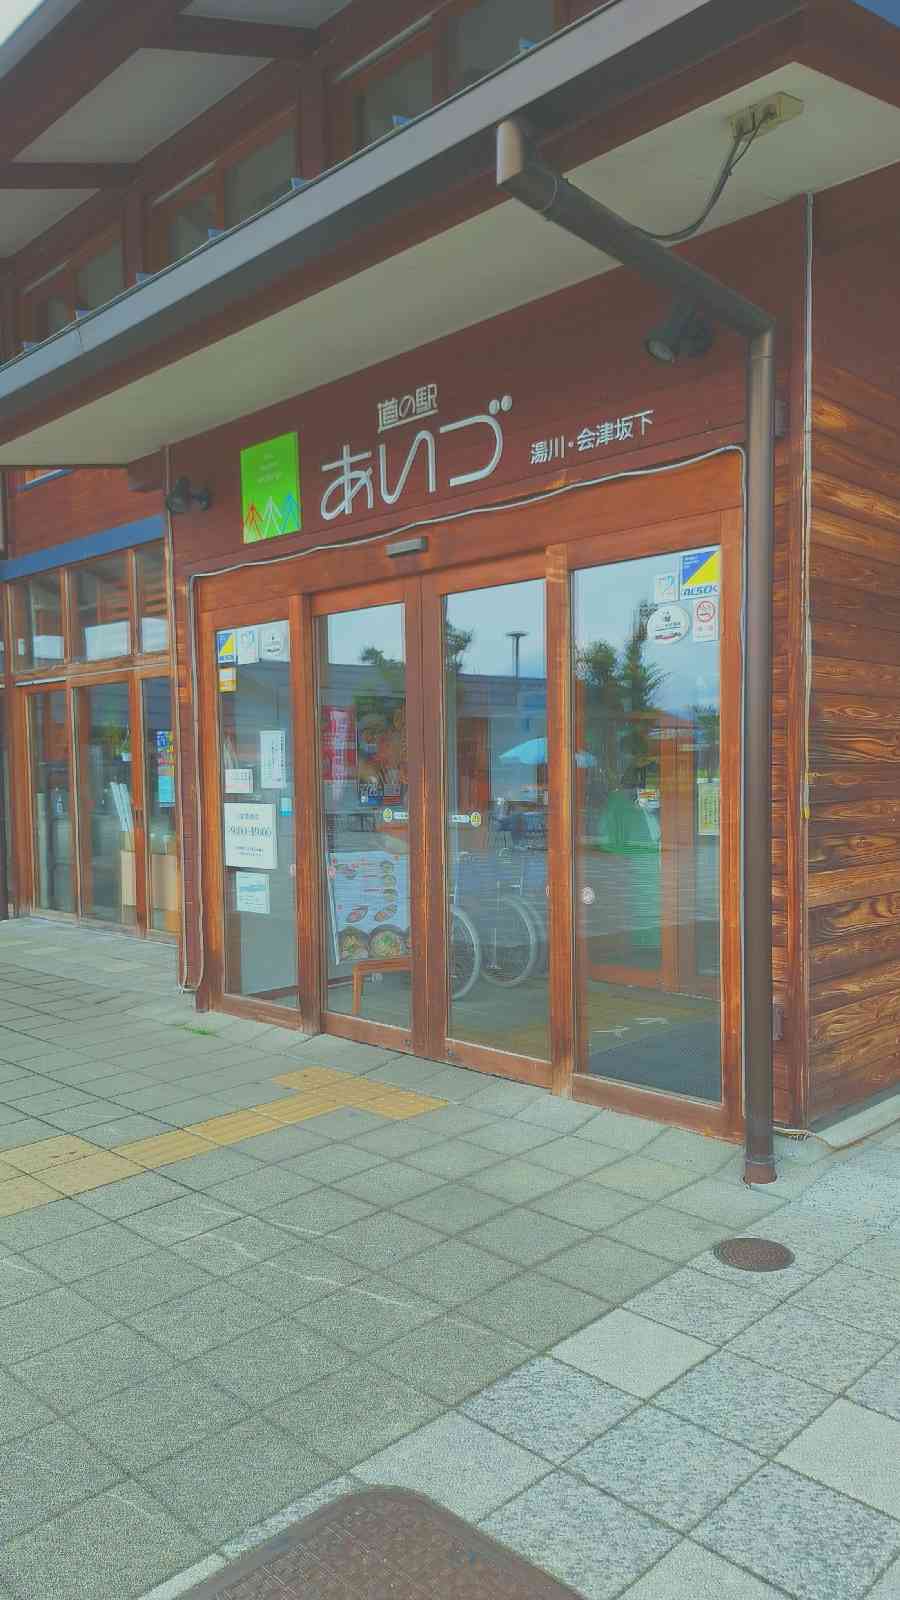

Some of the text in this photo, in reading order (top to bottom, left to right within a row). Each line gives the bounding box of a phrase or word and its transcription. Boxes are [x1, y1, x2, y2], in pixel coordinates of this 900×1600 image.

[377, 383, 438, 433] 道の駅
[320, 395, 513, 520] あいづ
[529, 409, 654, 465] 湯川・会津坂下
